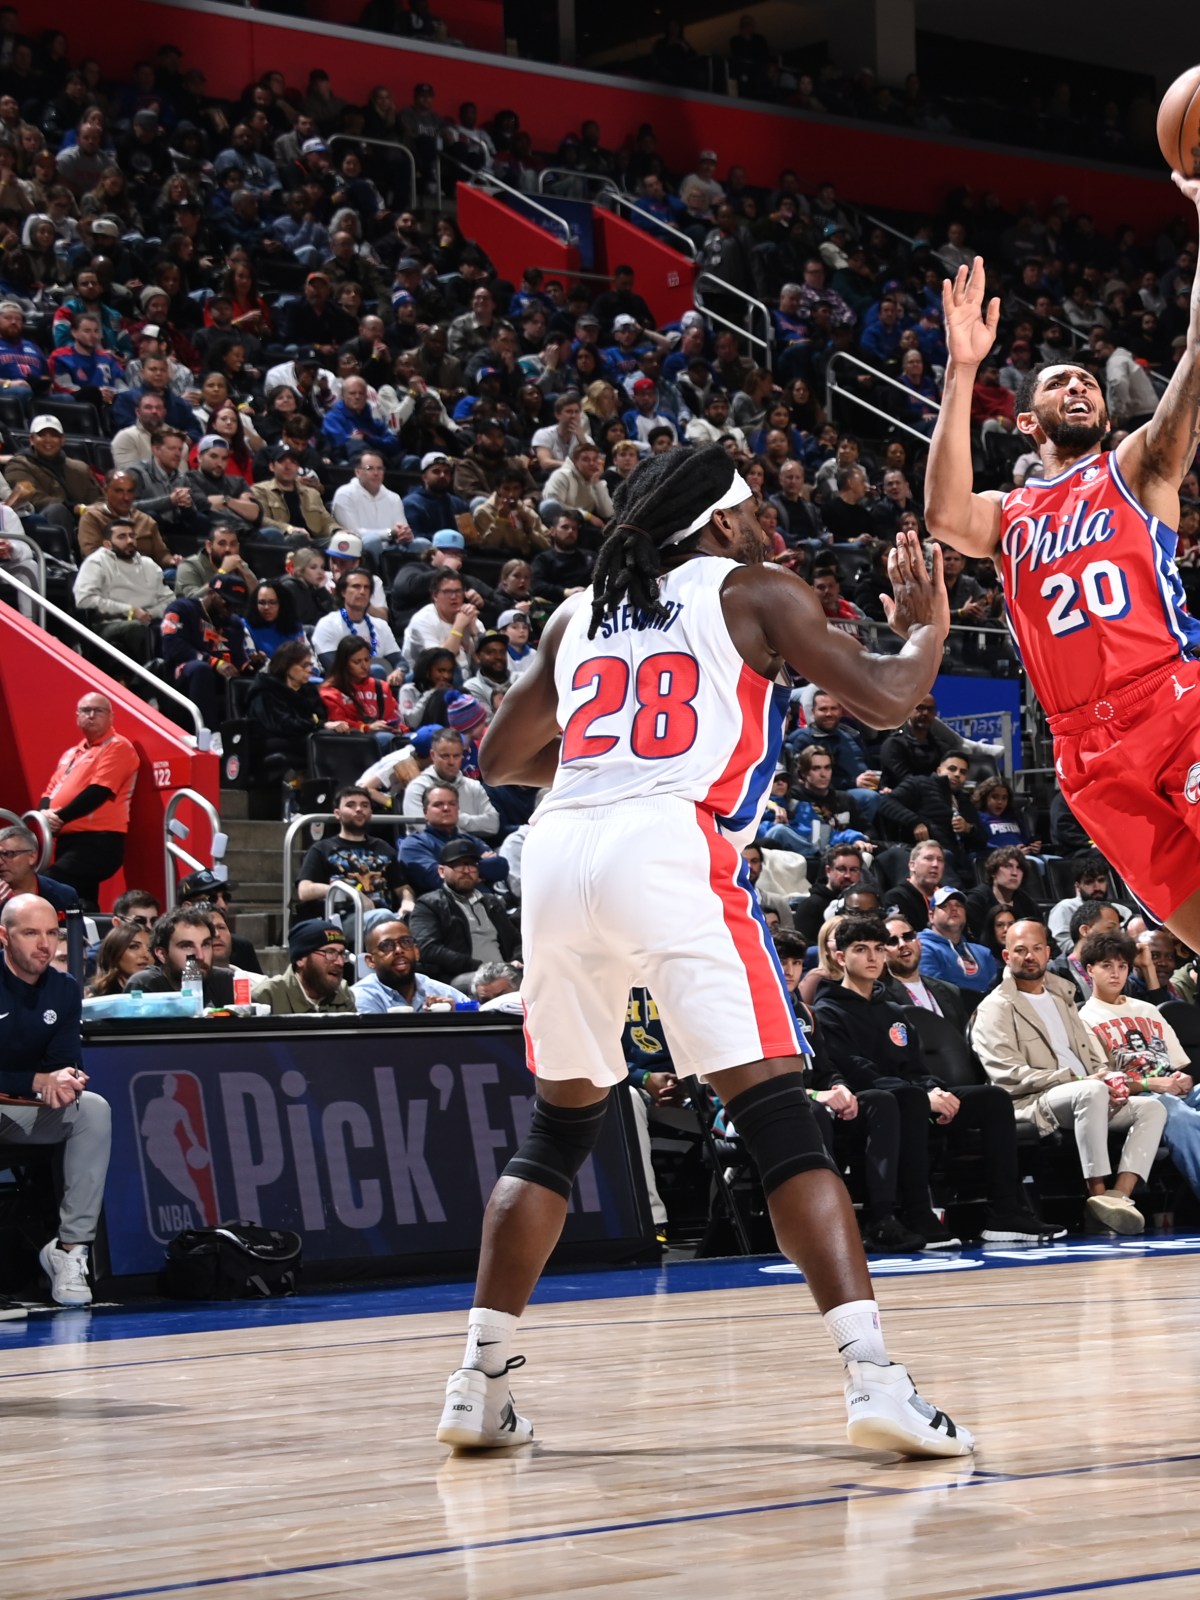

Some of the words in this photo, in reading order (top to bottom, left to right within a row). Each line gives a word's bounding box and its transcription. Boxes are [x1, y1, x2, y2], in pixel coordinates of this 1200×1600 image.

[1002, 499, 1115, 600] Phila
[1039, 559, 1132, 638] 20
[561, 651, 700, 766] 28
[154, 768, 171, 787] 122
[1092, 1016, 1164, 1054] DETROIT
[219, 1063, 602, 1232] Pick'E
[158, 1205, 194, 1233] NBA
[452, 1404, 473, 1412] XERO
[851, 1394, 870, 1406] XERO
